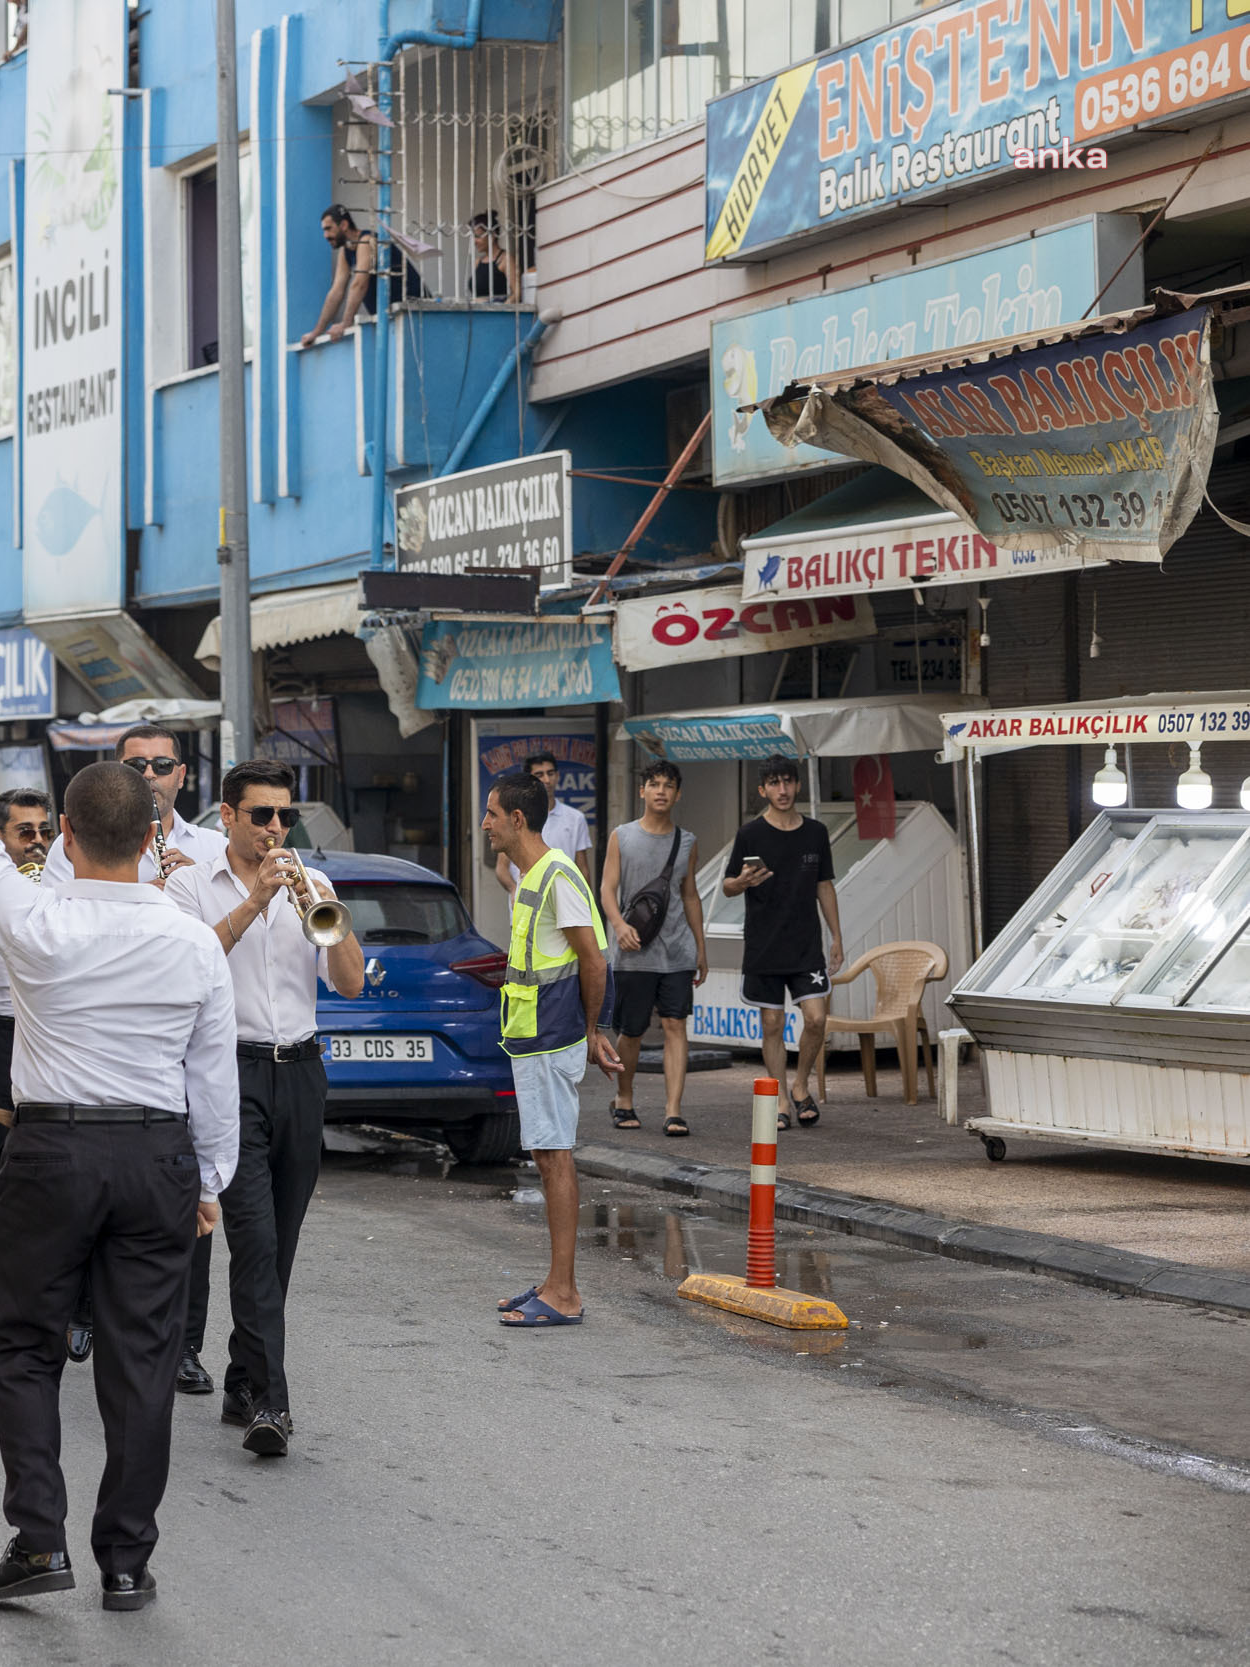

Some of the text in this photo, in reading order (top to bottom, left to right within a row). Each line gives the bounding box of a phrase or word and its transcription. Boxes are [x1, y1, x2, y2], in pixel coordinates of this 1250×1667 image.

[1081, 67, 1160, 131] 0536
[1168, 42, 1231, 105] 684
[724, 87, 790, 243] HİDAYET
[818, 96, 1062, 219] Balık Restaurant
[34, 248, 110, 350] İNCİLİ
[26, 368, 117, 438] RESTAURANT
[900, 382, 1015, 439] AKAR
[969, 449, 1041, 484] Başkan
[1038, 447, 1113, 478] Mehmet
[428, 472, 561, 541] ÖZCAN BALIKÇILIK
[990, 491, 1055, 525] 0507
[1058, 492, 1110, 528] 132
[1112, 490, 1147, 529] 39
[542, 536, 561, 574] 60
[786, 546, 886, 590] BALIKÇI
[892, 533, 998, 578] TEKİN
[456, 623, 509, 658] ÖZCAN
[651, 596, 858, 646] ÖZCAN
[652, 722, 783, 744] ÖZCAN BALIKÇILIK
[967, 710, 1250, 739] AKAR BALIKÇILIK 0507 132 39
[331, 1039, 426, 1058] 33 CDS 35
